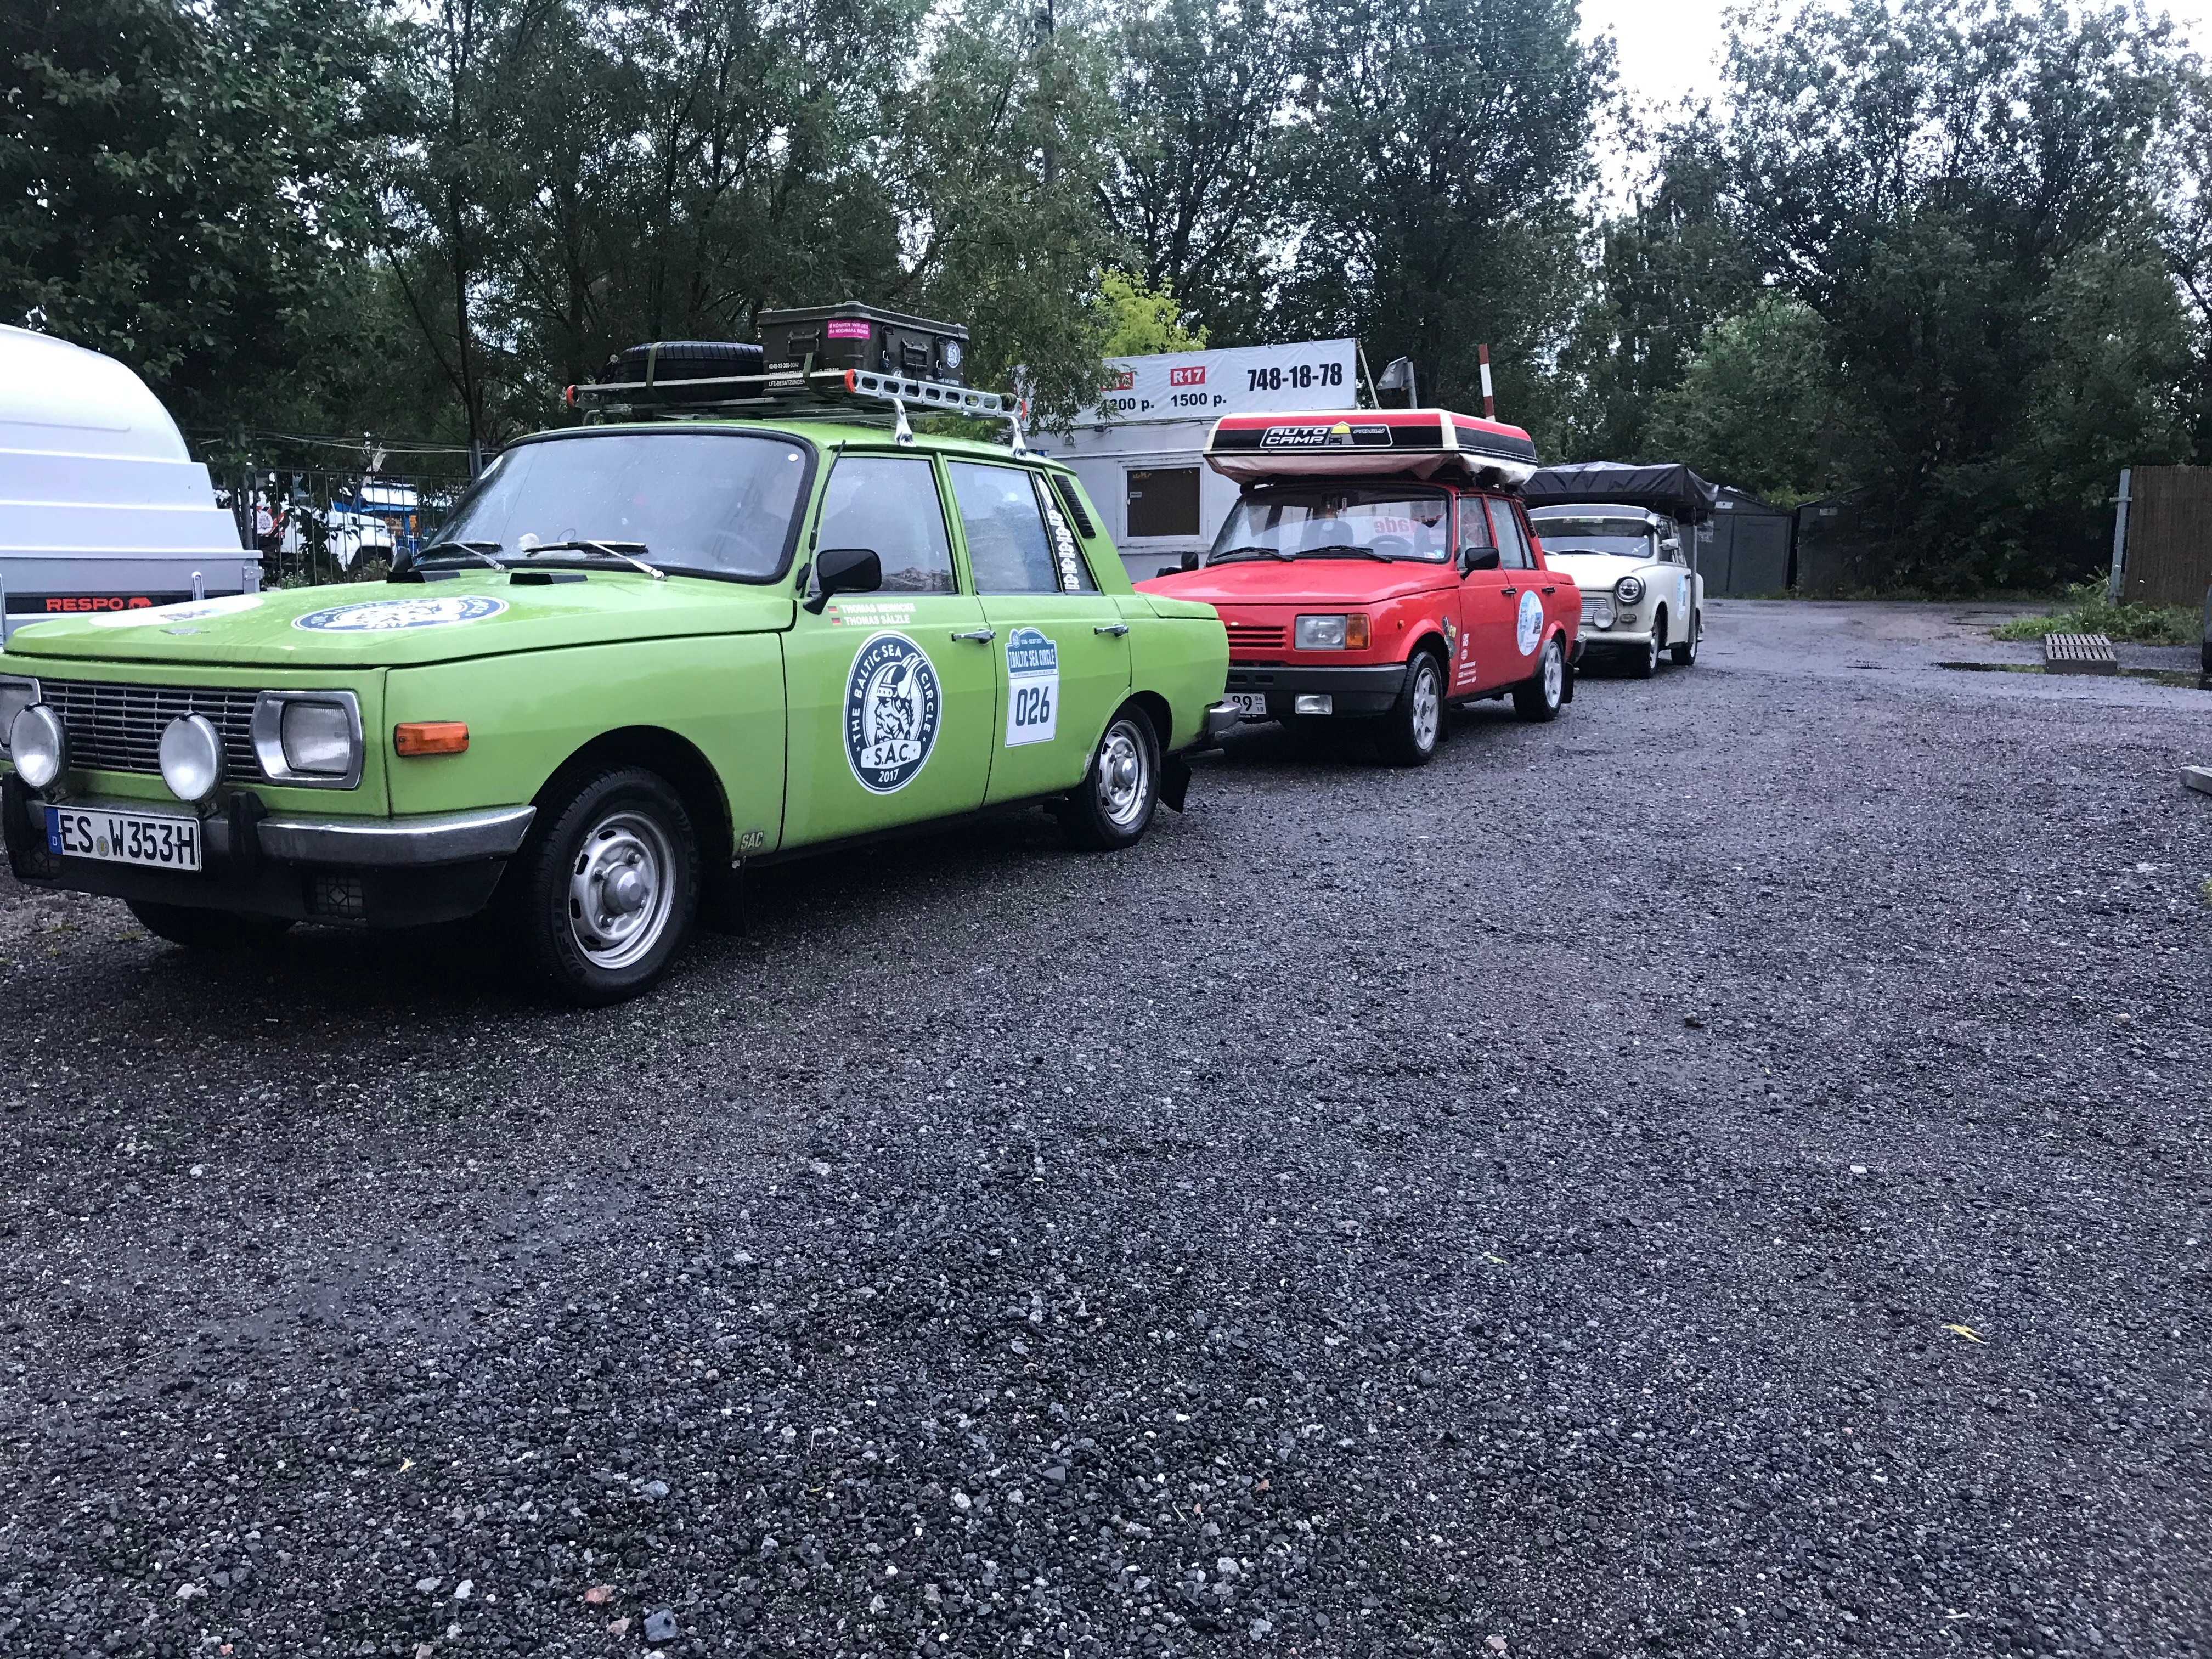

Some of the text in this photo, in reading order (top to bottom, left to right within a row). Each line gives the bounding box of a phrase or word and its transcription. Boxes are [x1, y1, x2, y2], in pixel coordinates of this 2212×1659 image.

[1172, 369, 1203, 384] R17
[1246, 363, 1343, 392] 748-18-78
[1171, 392, 1207, 407] 1500
[1266, 436, 1324, 444] CAMP
[46, 597, 123, 611] RESPO
[840, 604, 876, 613] THOMAS
[844, 615, 879, 625] THOMAS
[1029, 650, 1039, 667] SEA
[1039, 648, 1055, 666] CIRCLE
[851, 644, 934, 743] THE BALTIC SEA CIRCLE
[1015, 686, 1050, 726] 026
[874, 742, 911, 766] S.A.C.
[878, 768, 899, 783] 2017
[52, 836, 58, 847] D
[60, 814, 94, 853] ES
[741, 831, 763, 850] SAC
